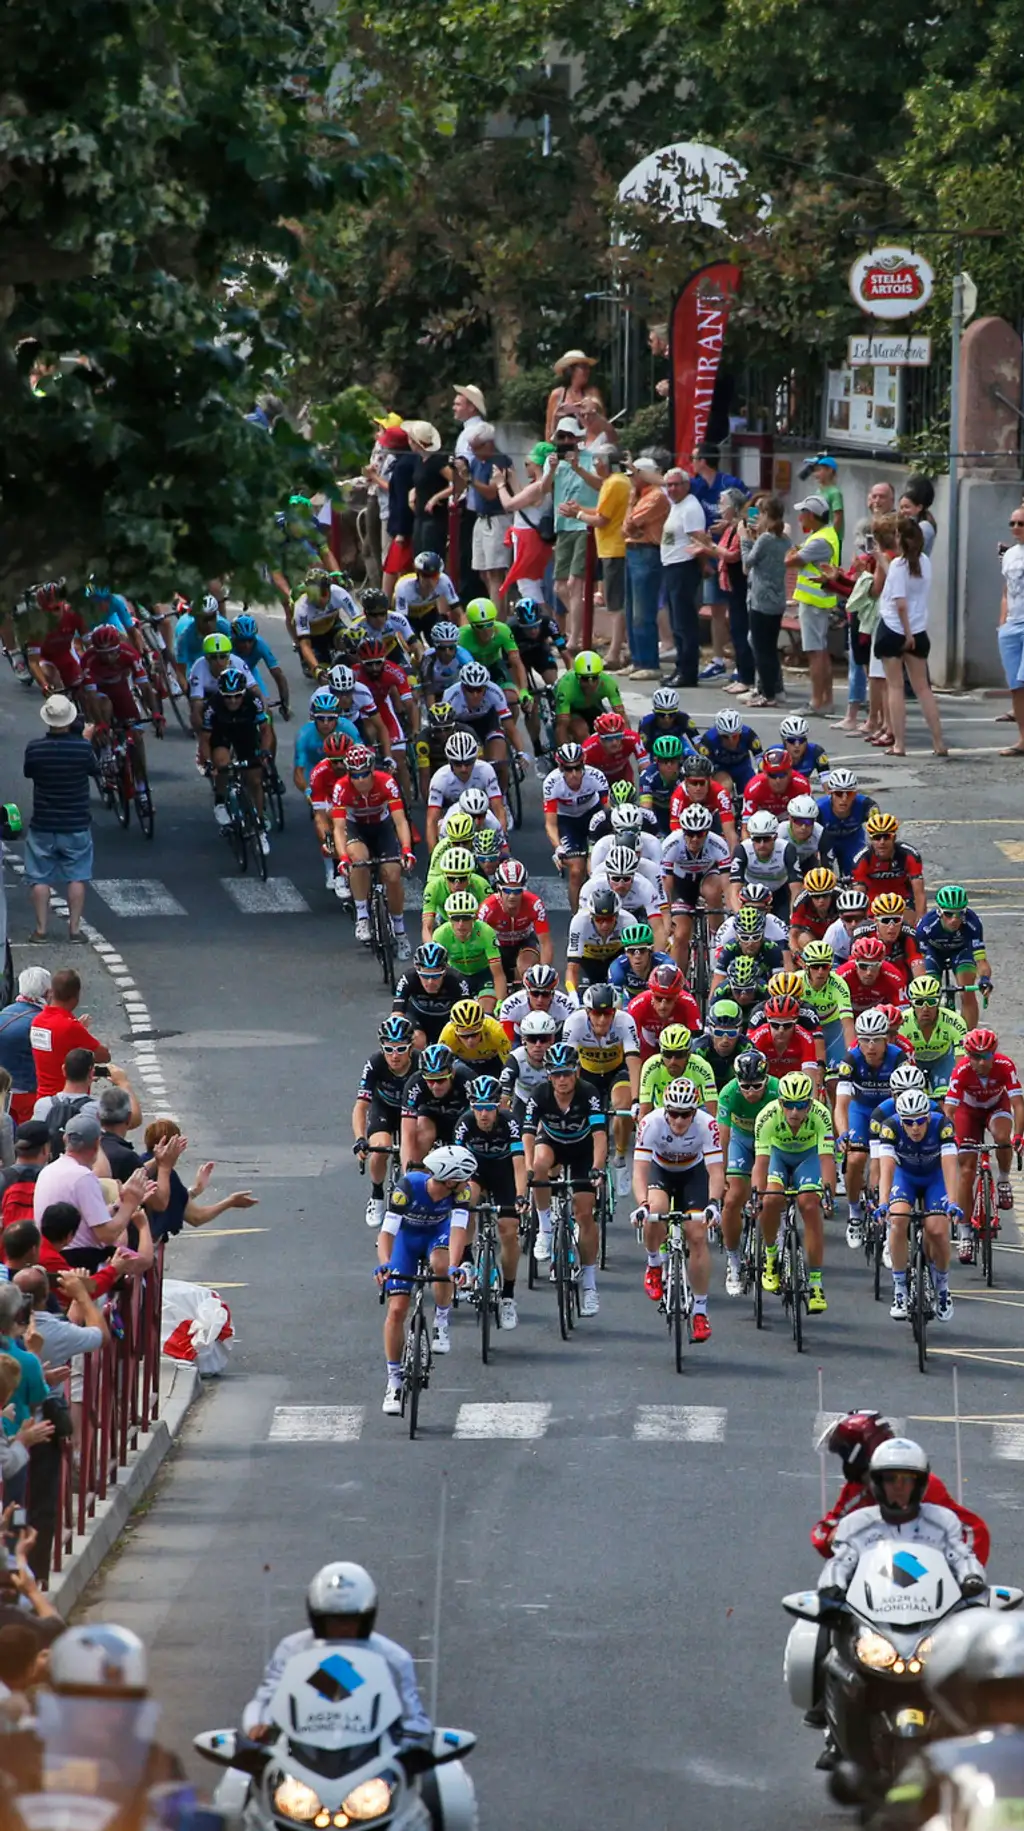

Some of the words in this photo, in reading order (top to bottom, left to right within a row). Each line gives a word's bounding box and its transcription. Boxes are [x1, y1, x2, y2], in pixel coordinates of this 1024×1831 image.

[871, 274, 913, 284] STELLA
[871, 284, 913, 295] ARTOIS
[501, 997, 521, 1016] IAM
